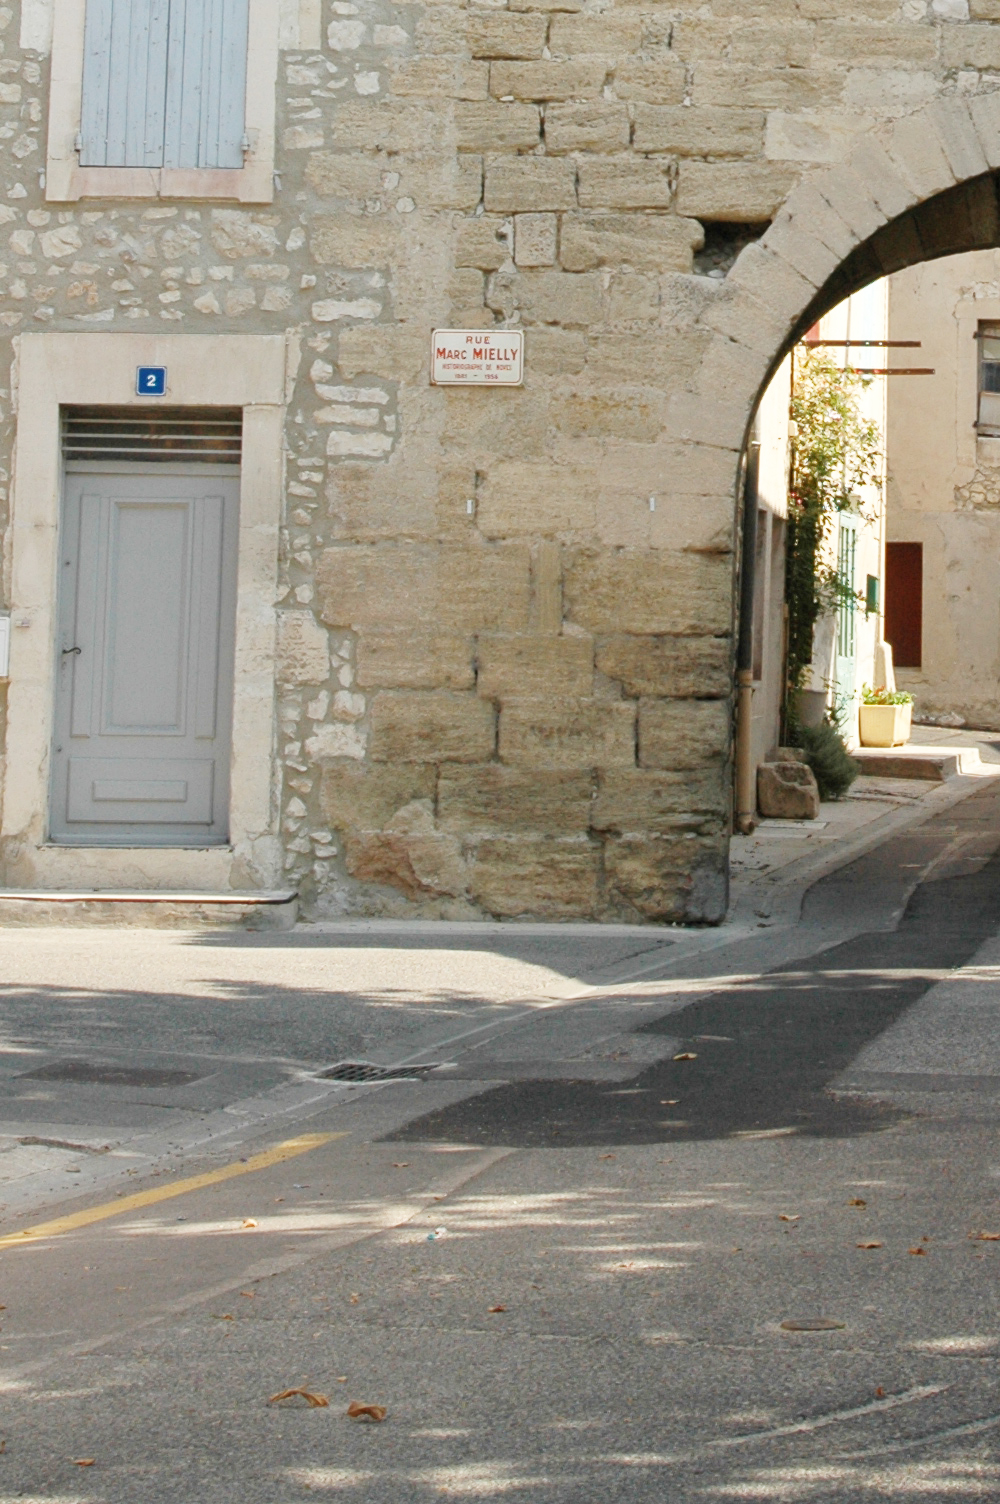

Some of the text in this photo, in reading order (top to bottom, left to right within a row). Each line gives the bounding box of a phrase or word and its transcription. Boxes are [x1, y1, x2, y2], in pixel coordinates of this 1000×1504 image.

[465, 335, 491, 345] RUE
[472, 348, 518, 361] MIELLY
[146, 374, 157, 387] 2
